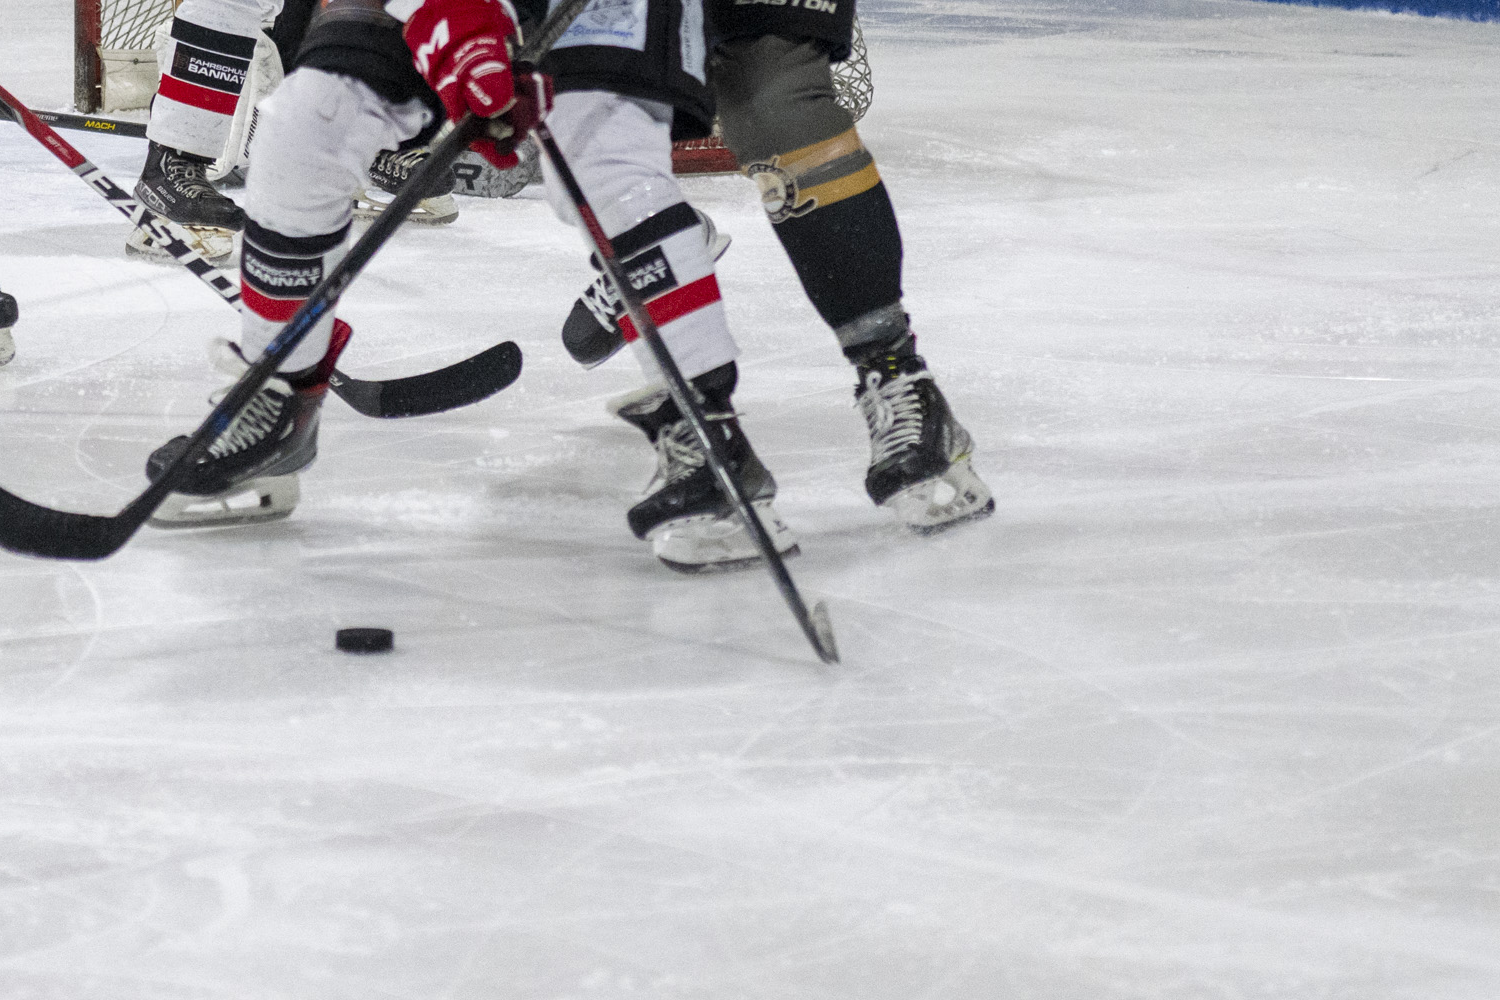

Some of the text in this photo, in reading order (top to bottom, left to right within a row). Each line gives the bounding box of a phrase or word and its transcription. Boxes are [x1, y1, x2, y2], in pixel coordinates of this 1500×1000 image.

[187, 63, 246, 85] BANNAT
[189, 56, 249, 77] FAHRSCHULE
[84, 120, 116, 131] MACH
